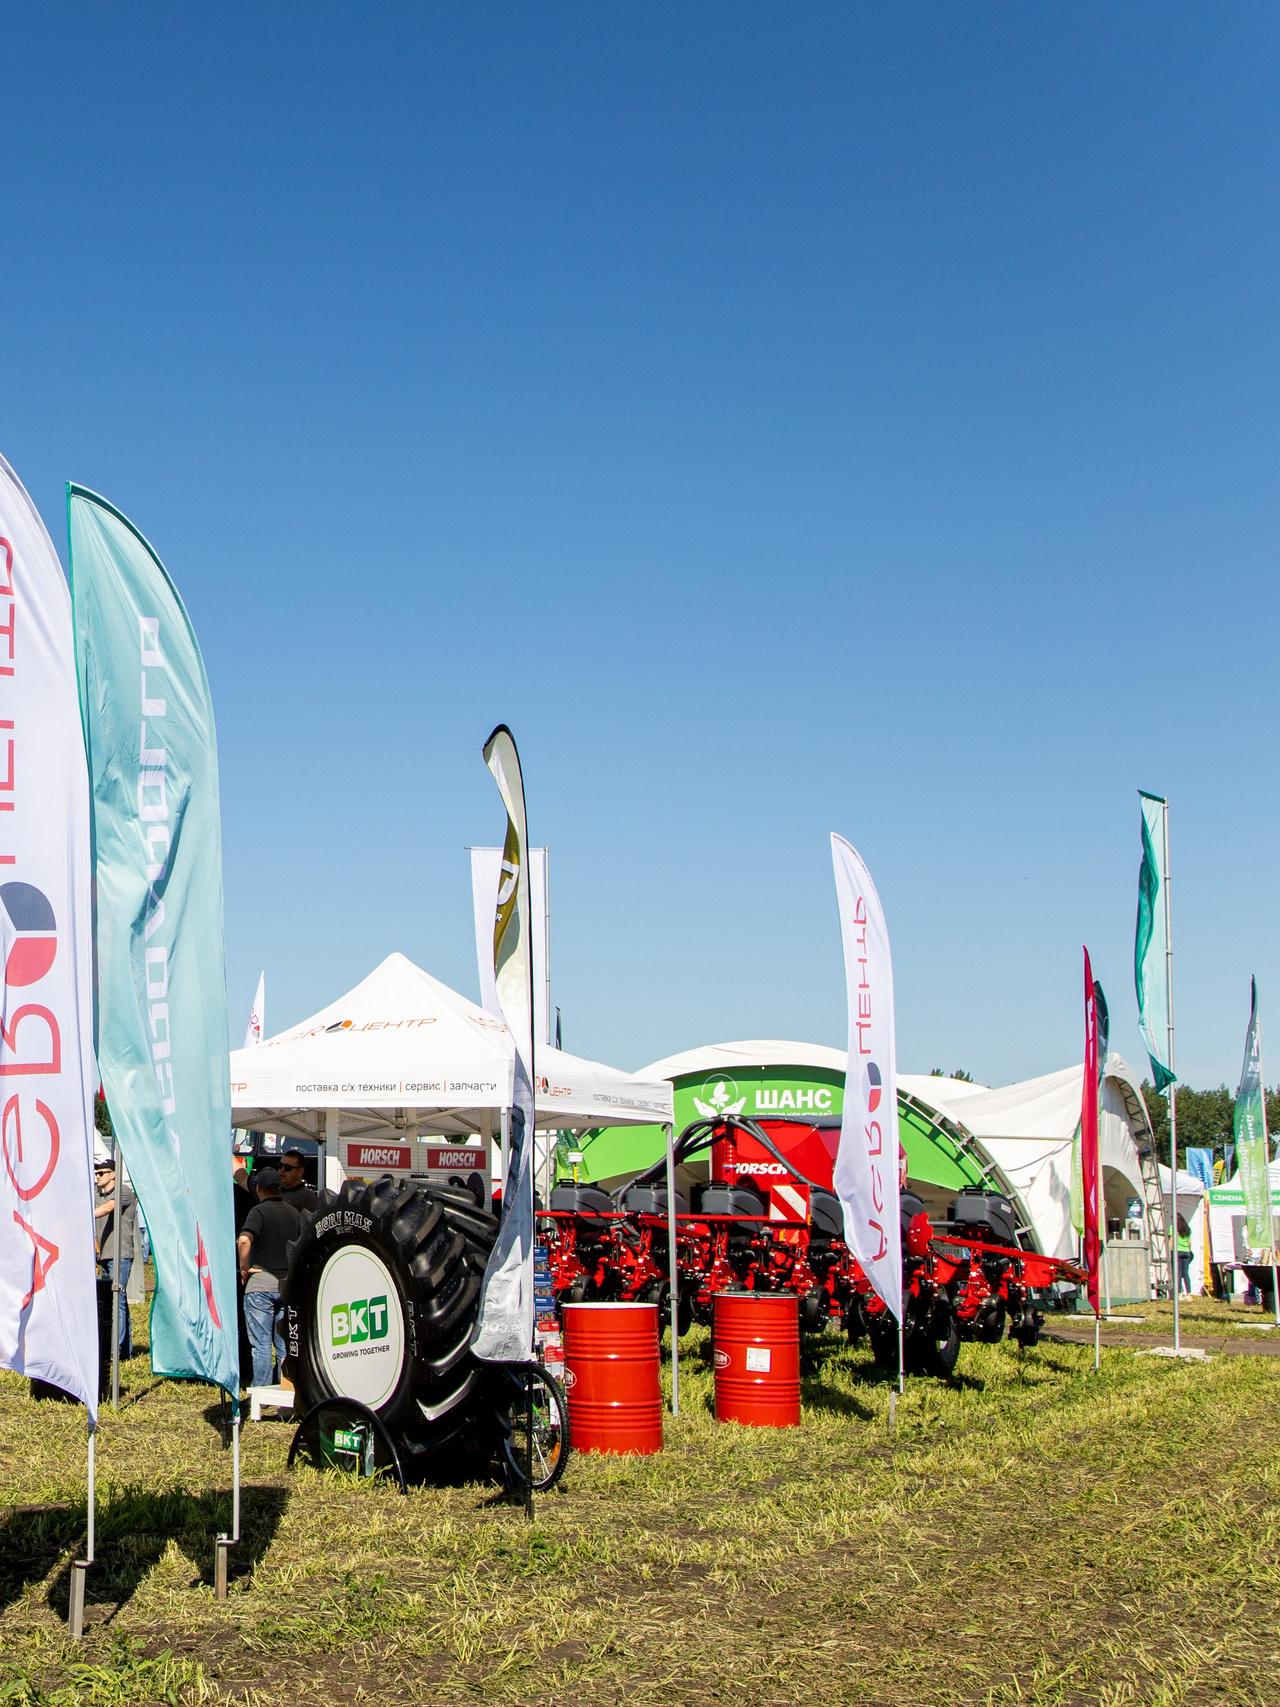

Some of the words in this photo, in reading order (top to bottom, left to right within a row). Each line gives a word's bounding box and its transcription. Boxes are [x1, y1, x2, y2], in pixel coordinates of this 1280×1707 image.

[295, 1083, 339, 1093] поставка
[341, 1081, 355, 1092] с/х
[357, 1082, 397, 1092] техники
[405, 1082, 441, 1093] сервис
[754, 1088, 832, 1109] ШАНС
[360, 1148, 401, 1166] HORSCH
[438, 1152, 476, 1167] HORSCH
[314, 1211, 342, 1240] AGRI
[343, 1210, 373, 1234] MAX
[332, 1301, 387, 1341] BKT
[287, 1305, 299, 1357] BKT
[332, 1349, 359, 1361] GROWING
[359, 1344, 390, 1356] TOGETHER
[334, 1430, 361, 1448] BKT
